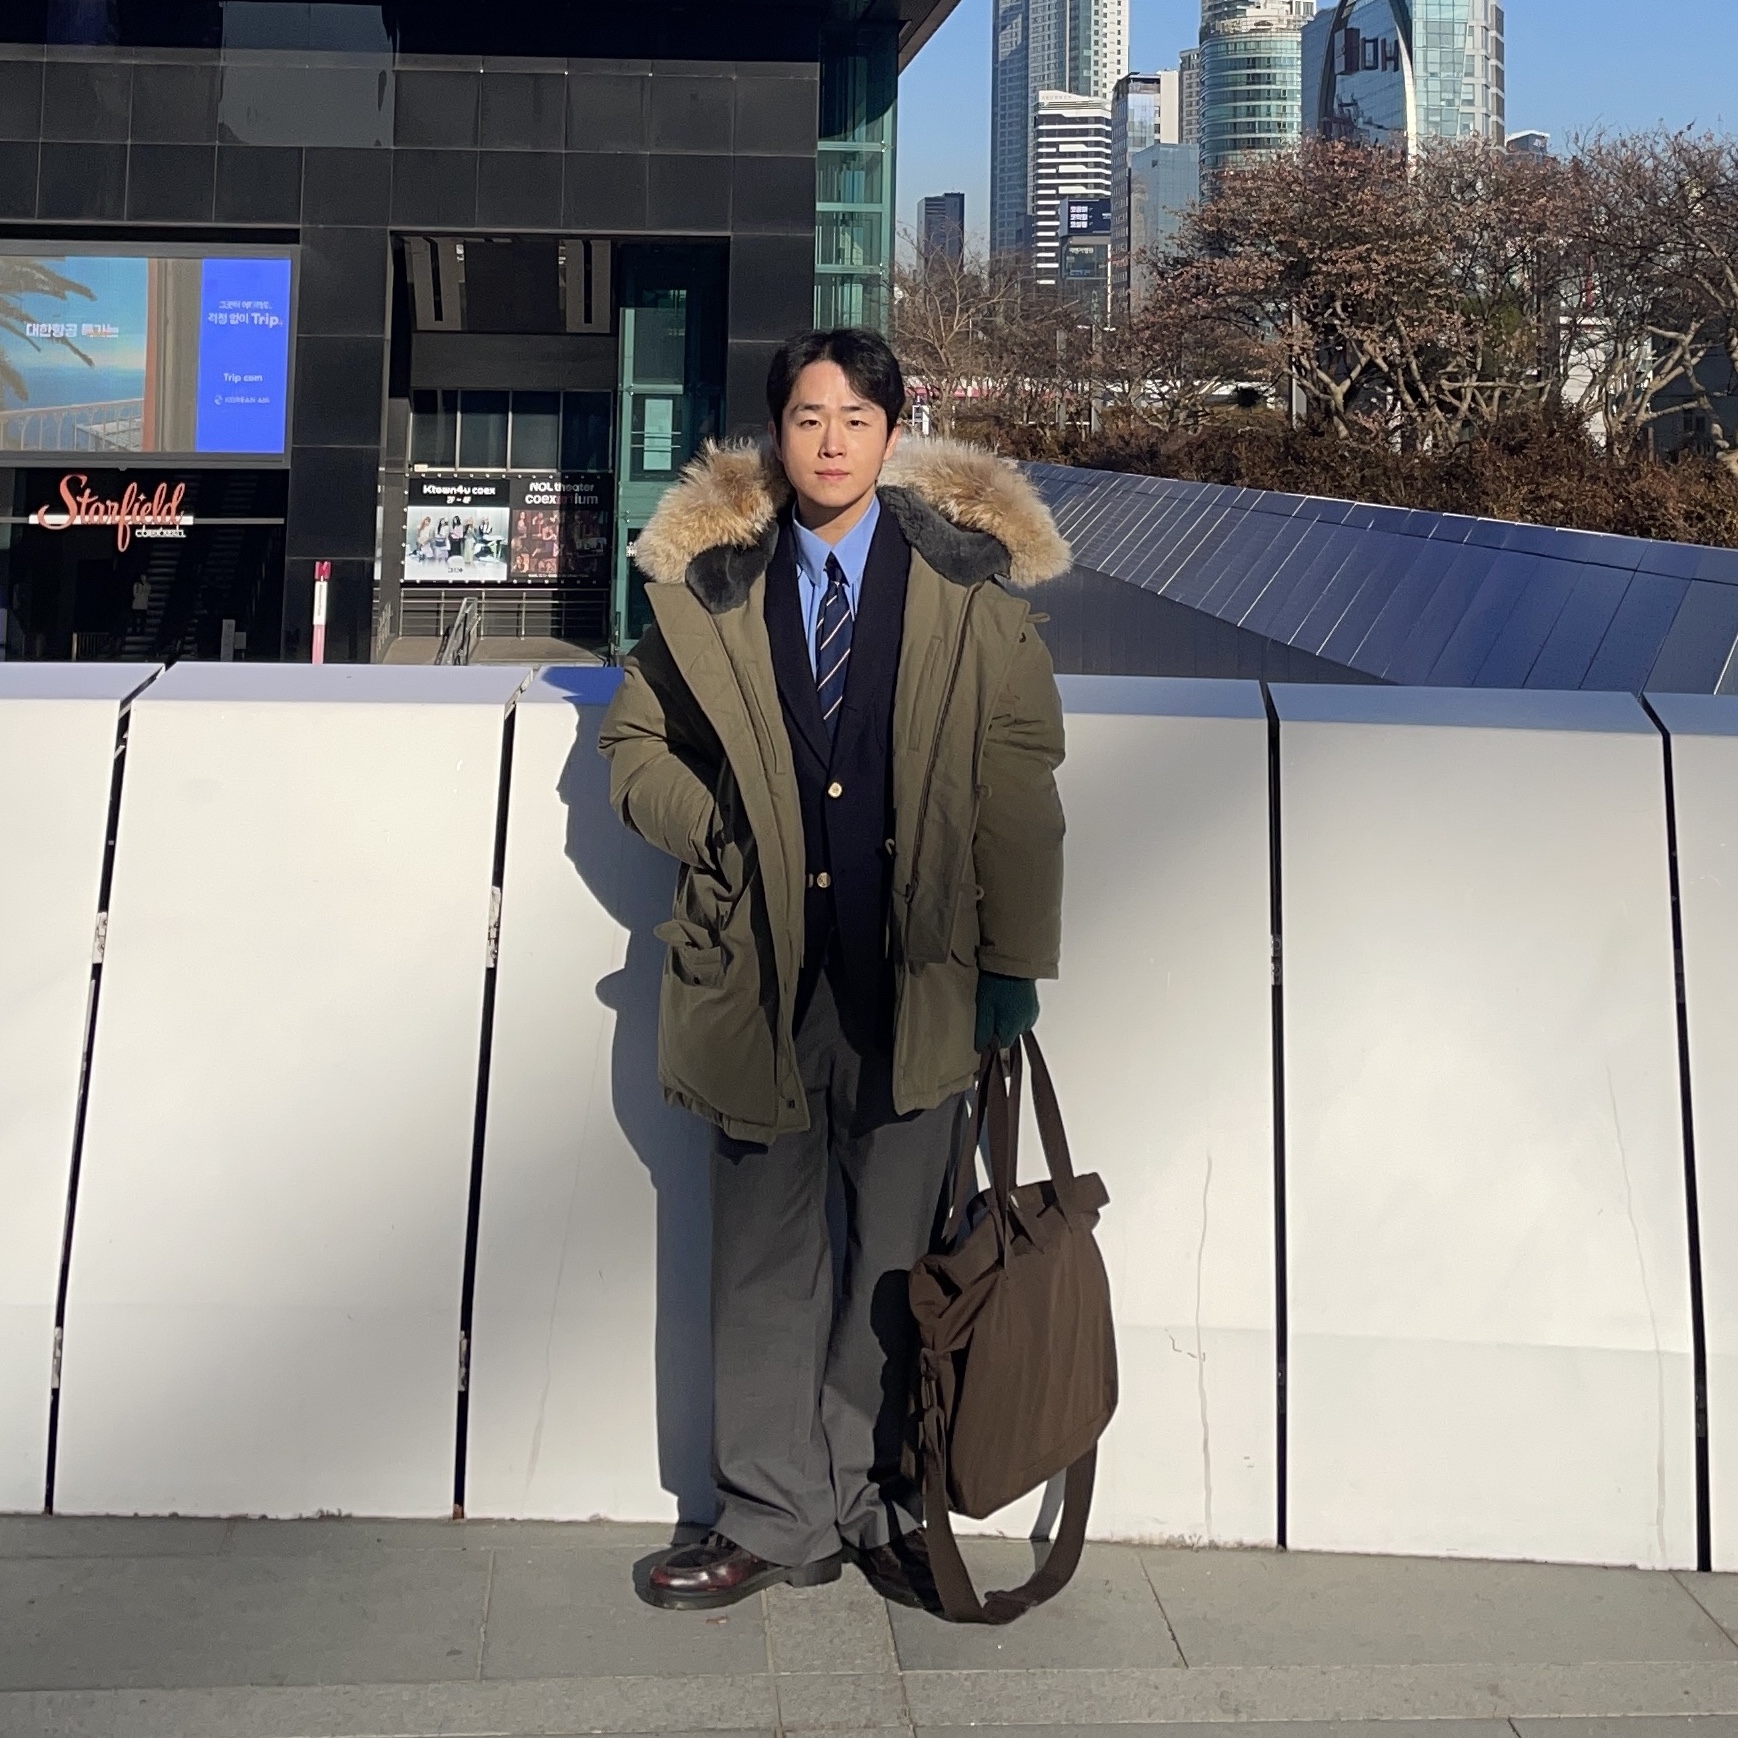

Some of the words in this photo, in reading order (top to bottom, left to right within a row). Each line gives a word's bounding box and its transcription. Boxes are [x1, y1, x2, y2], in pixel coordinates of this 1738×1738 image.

[25, 323, 78, 338] 대한항공
[423, 484, 471, 495] Ktown4u
[472, 486, 496, 495] coex
[529, 481, 553, 492] NOL
[553, 481, 595, 492] theater
[524, 492, 599, 505] coexium
[37, 473, 186, 553] Starfield
